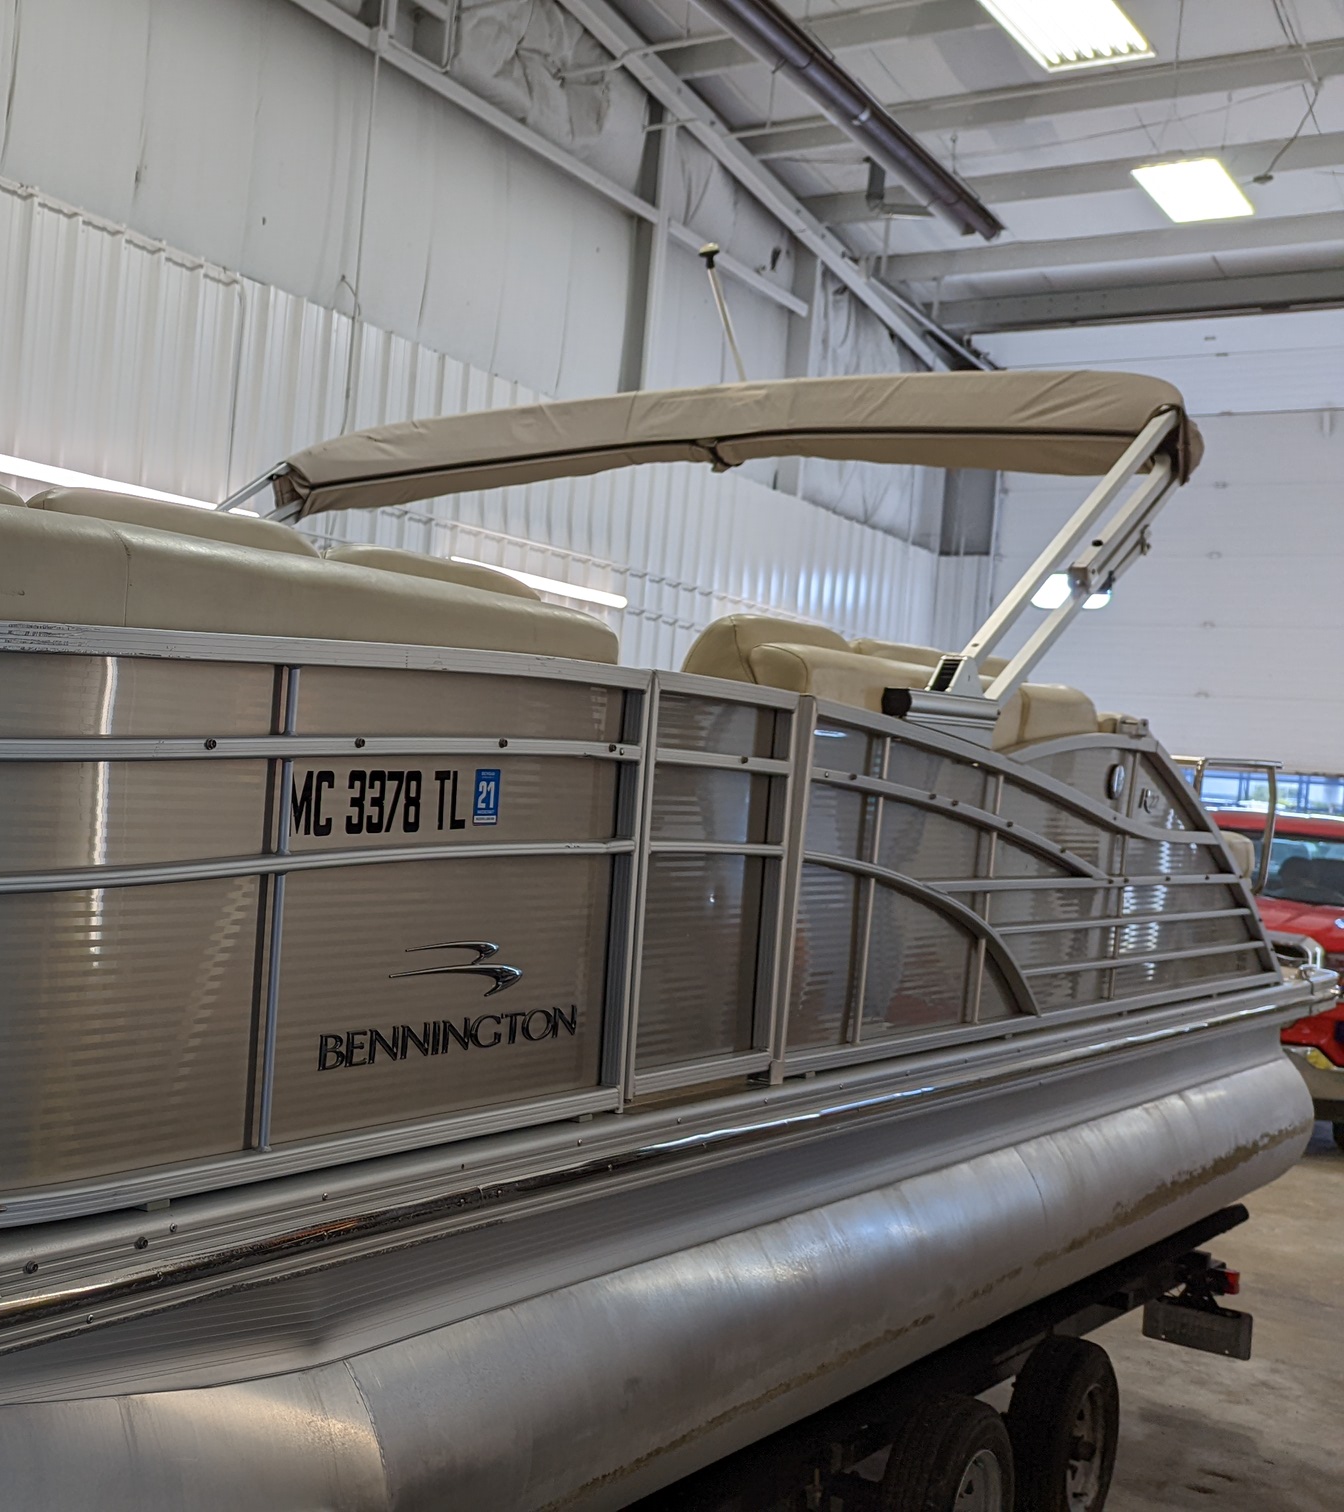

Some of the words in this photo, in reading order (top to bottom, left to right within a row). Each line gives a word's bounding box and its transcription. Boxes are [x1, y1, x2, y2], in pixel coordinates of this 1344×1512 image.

[289, 770, 335, 837] MC
[345, 770, 422, 834] 3378
[434, 770, 466, 830] TL
[478, 781, 495, 809] 21
[318, 1005, 577, 1070] BENNINGTON
